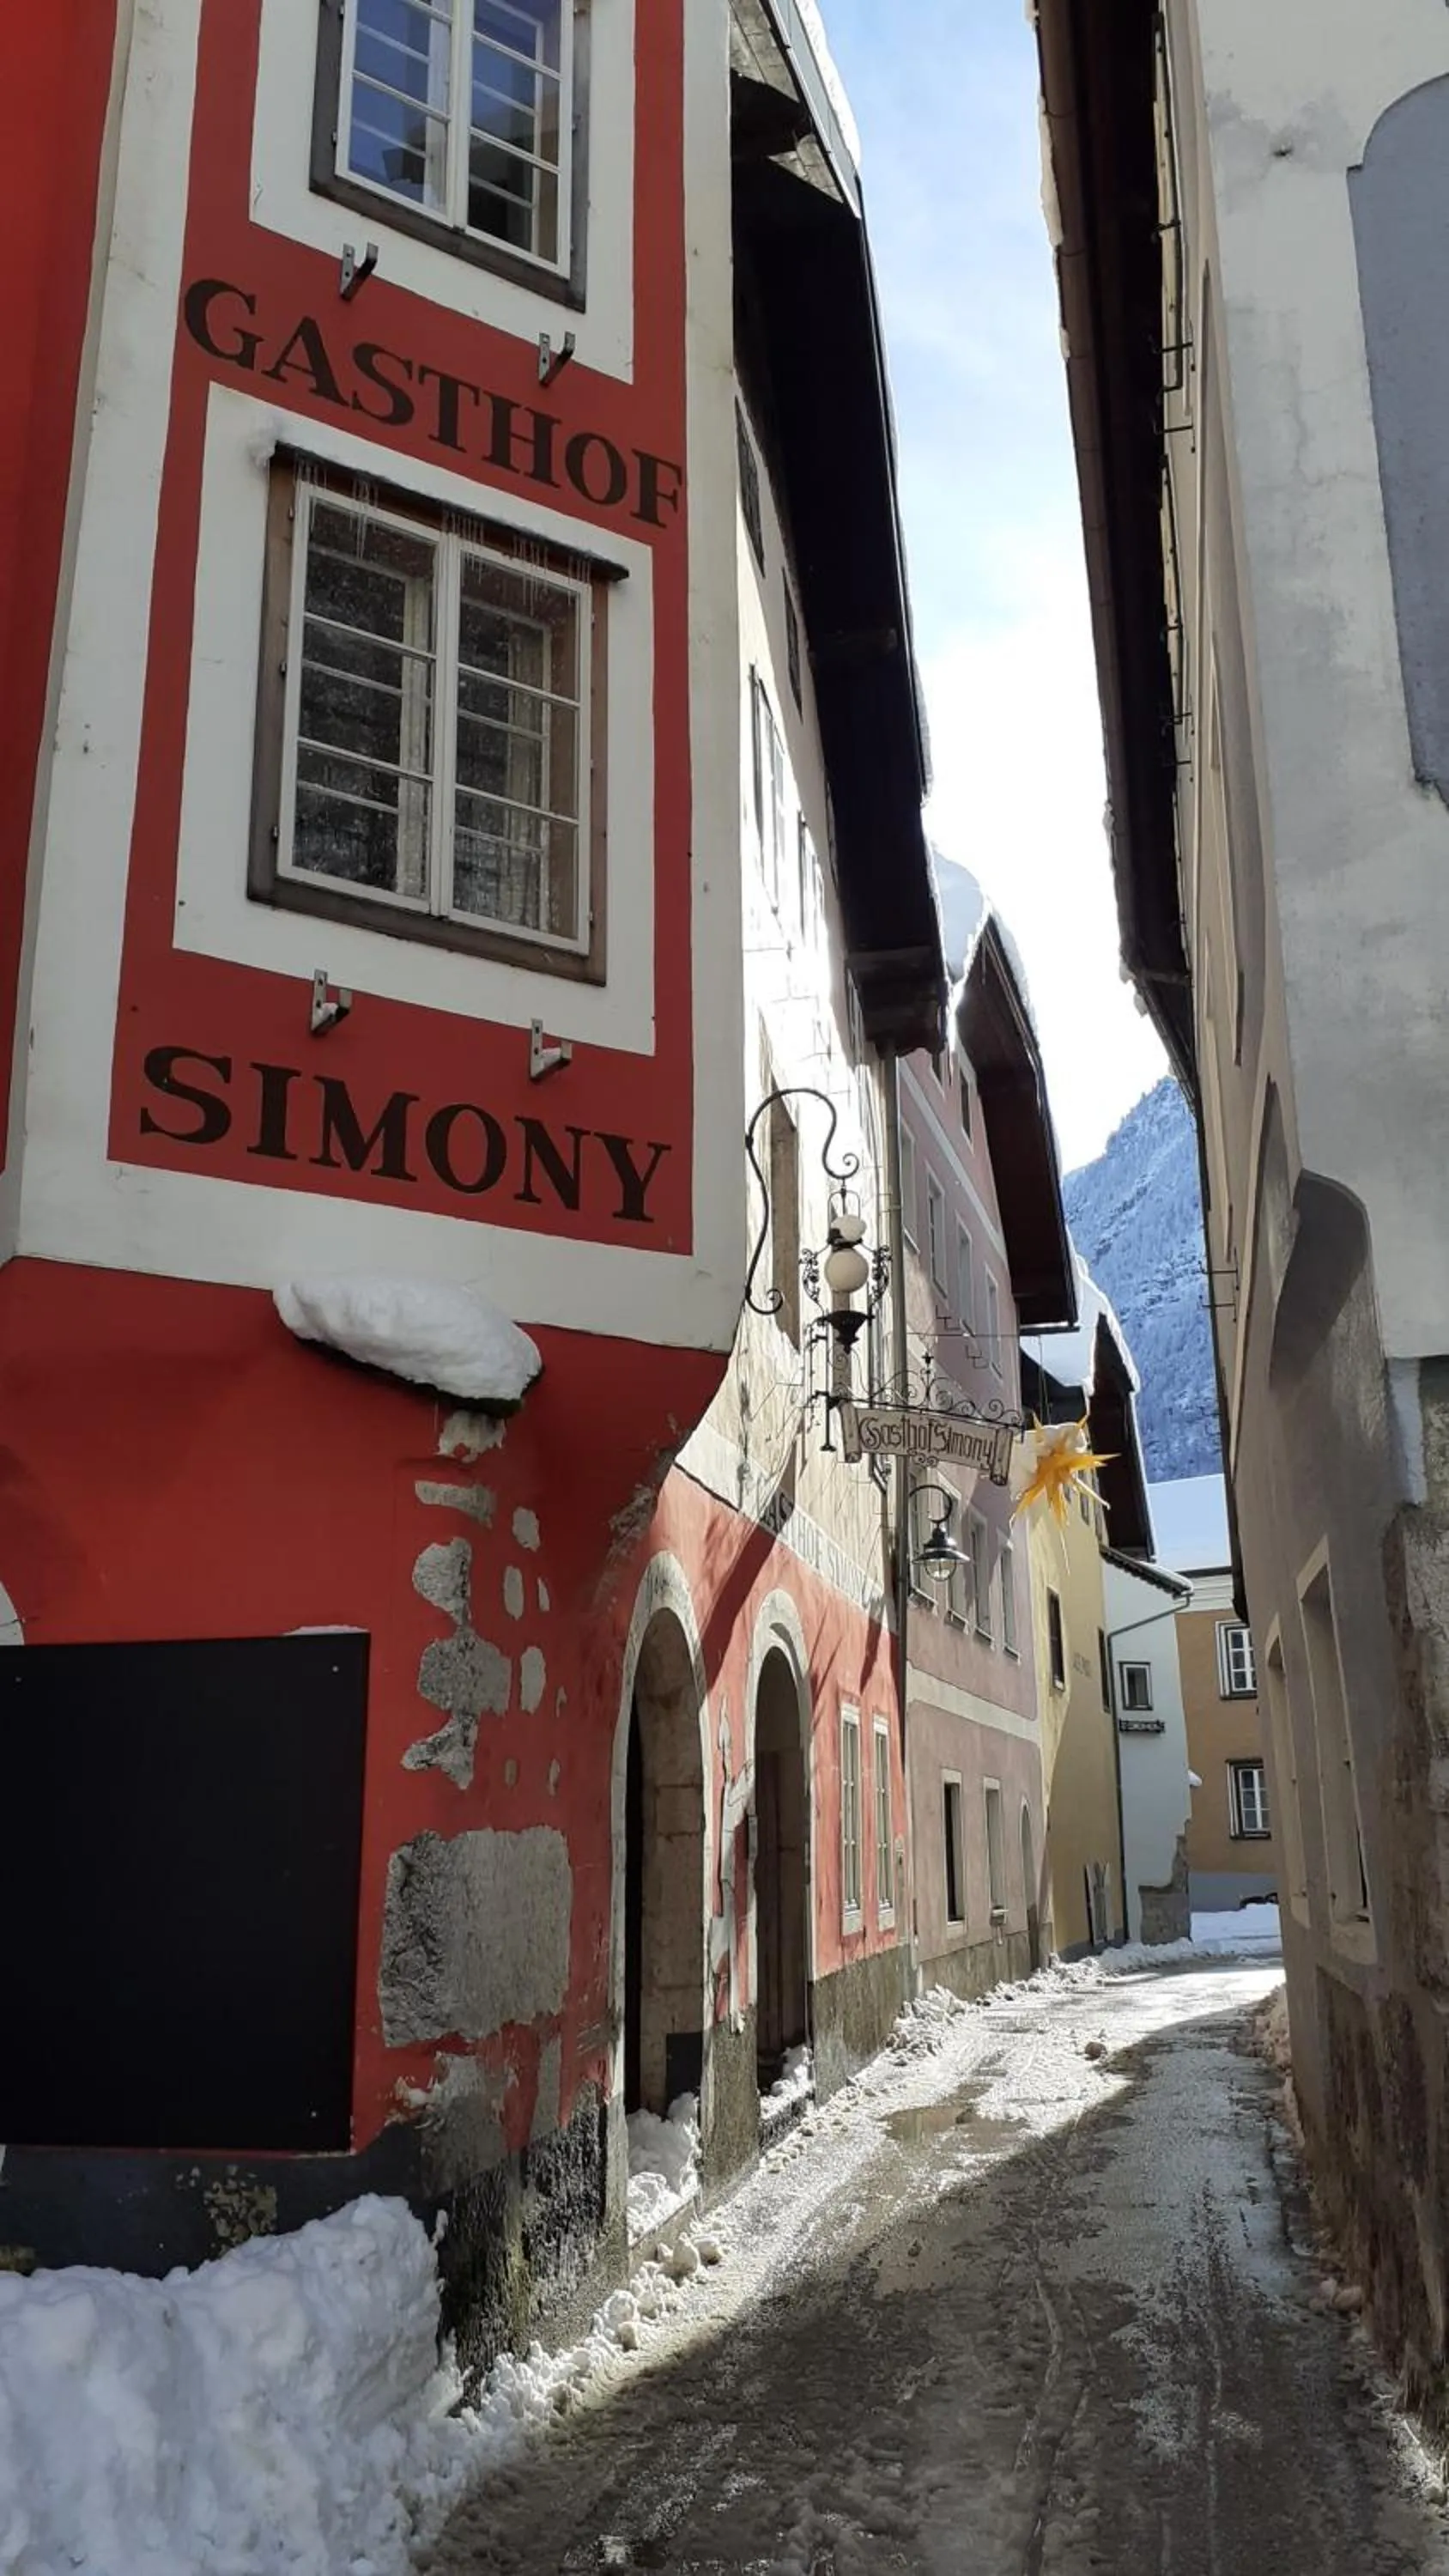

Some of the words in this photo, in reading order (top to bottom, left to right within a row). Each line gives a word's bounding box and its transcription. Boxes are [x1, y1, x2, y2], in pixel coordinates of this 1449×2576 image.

[184, 279, 684, 529] GASTHOF
[140, 1045, 671, 1223] SIMONY
[858, 1416, 935, 1453] Gasthof
[933, 1423, 994, 1470] Simony
